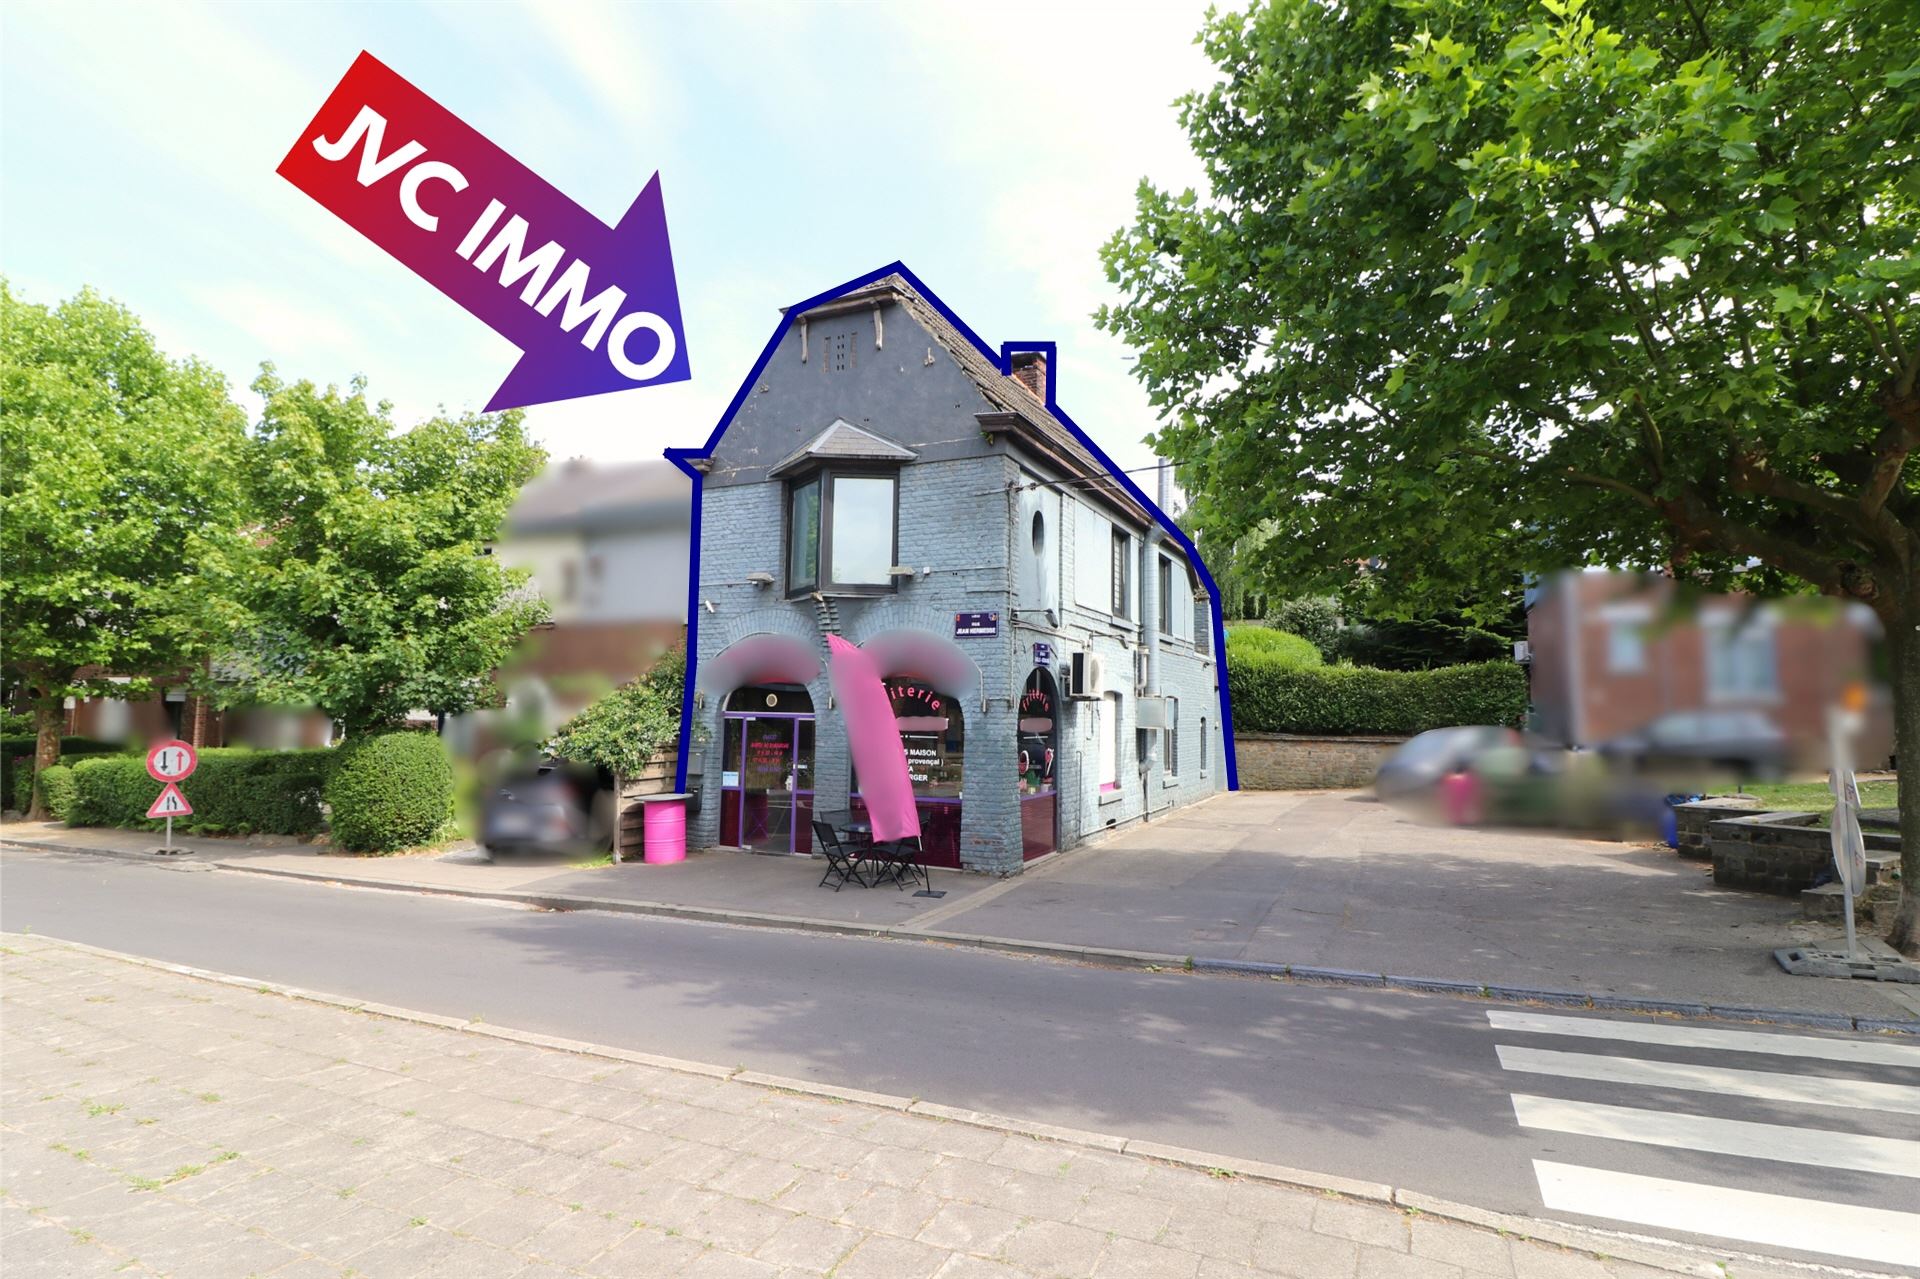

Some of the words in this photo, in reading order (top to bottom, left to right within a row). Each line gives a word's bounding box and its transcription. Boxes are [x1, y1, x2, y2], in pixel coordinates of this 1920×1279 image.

[889, 685, 941, 711] iterie
[909, 748, 937, 757] MAISON
[908, 773, 928, 782] RGER
